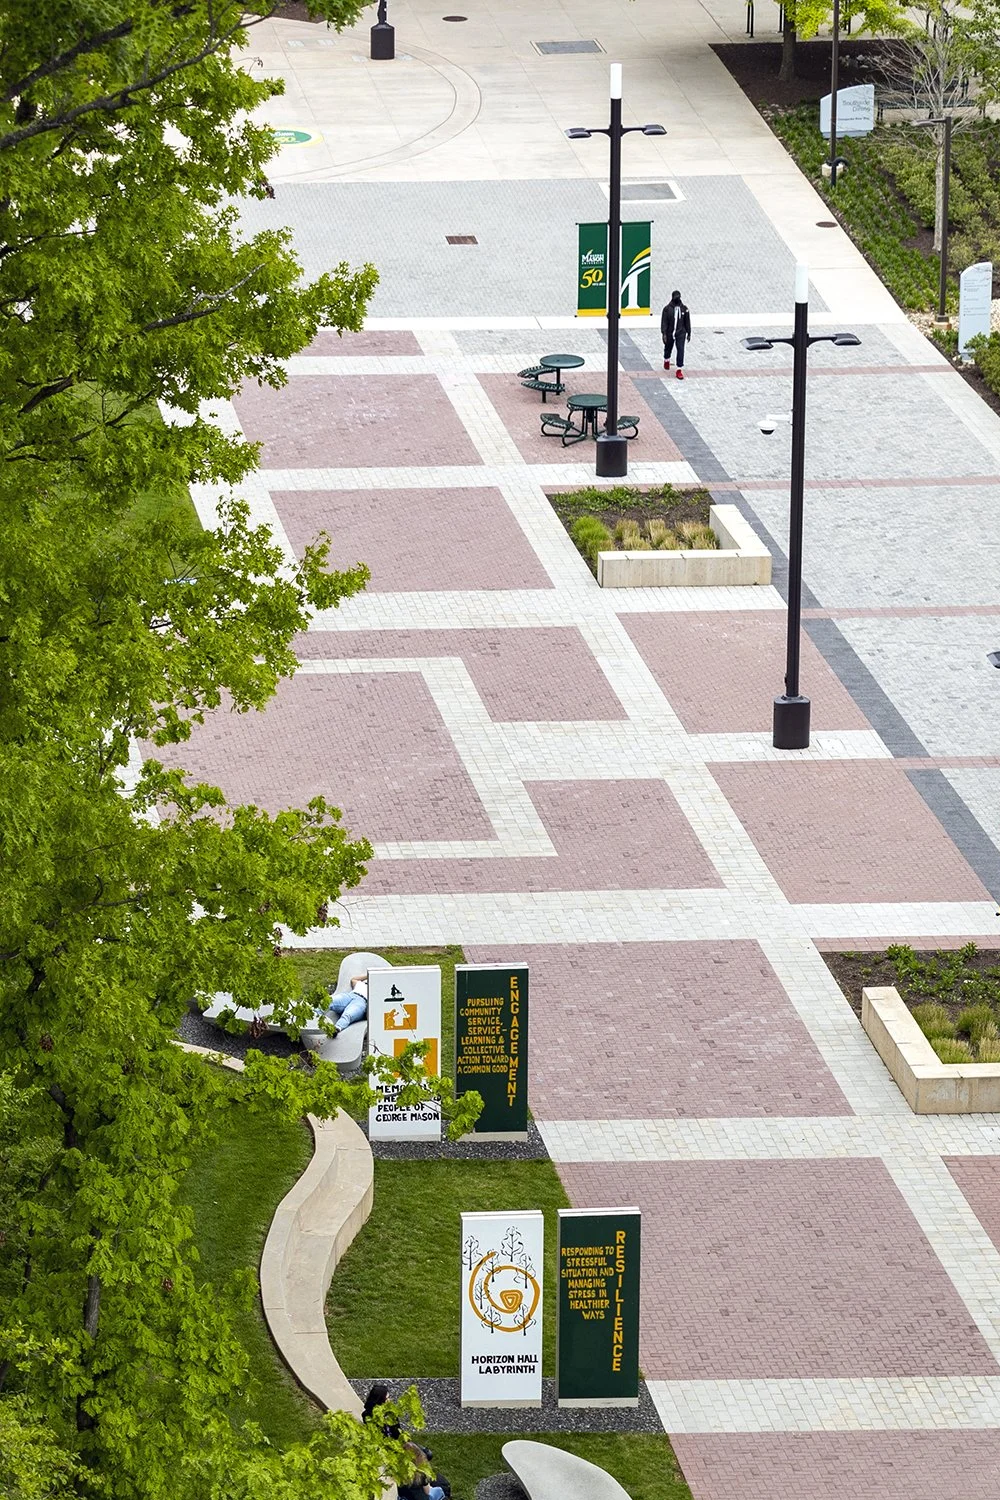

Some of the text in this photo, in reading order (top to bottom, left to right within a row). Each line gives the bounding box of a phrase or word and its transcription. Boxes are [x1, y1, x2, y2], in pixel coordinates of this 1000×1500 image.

[580, 268, 604, 289] 50
[467, 997, 504, 1007] PURSUING
[459, 1007, 502, 1016] COMMUNITY
[467, 1016, 503, 1026] SERVICE,
[461, 1035, 505, 1045] LEARNING &
[507, 976, 520, 1107] ENGAGEMENT
[463, 1045, 505, 1055] COLLECTIVE
[457, 1055, 509, 1065] ACTION TOWARD
[457, 1064, 508, 1074] A COMMON GOOD
[377, 1103, 411, 1112] PEOPLE
[375, 1112, 440, 1122] GEORGE MASON
[561, 1246, 615, 1257] RESPONDING TO
[566, 1257, 608, 1267] STRESSFUL
[561, 1267, 615, 1278] SITUATION AND
[568, 1278, 606, 1289] MANAGING
[568, 1289, 607, 1299] STRESS IN
[570, 1299, 610, 1309] HEALTHIER
[612, 1231, 626, 1371] RESILIENCE
[581, 1310, 605, 1320] WAYS
[471, 1354, 539, 1364] HORIZON HALL
[478, 1365, 535, 1374] LABYRINTH
